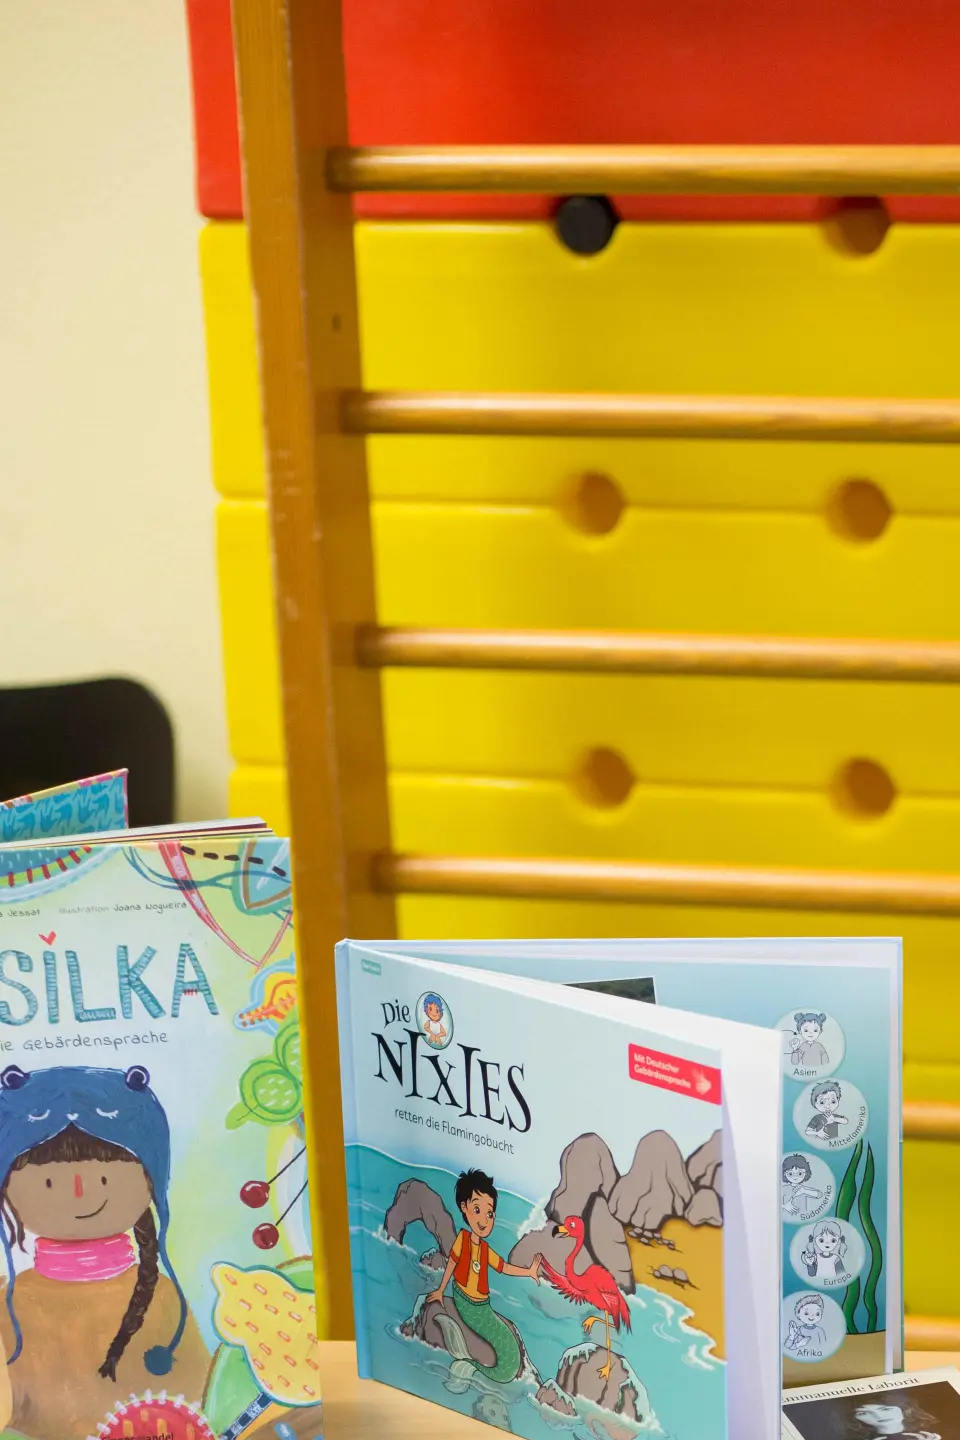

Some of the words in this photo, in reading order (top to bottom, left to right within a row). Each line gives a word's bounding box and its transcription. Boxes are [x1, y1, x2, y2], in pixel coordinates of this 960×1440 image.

[380, 998, 411, 1028] Die
[23, 1031, 169, 1050] Gebärdensprache
[793, 1067, 817, 1077] Asien
[394, 1107, 424, 1126] retten
[426, 1117, 440, 1131] die
[442, 1120, 515, 1155] Flamingobucht
[828, 1105, 867, 1148] Mittelamerika
[823, 1272, 853, 1287] Europa
[796, 1348, 823, 1358] Afrika
[782, 1384, 865, 1404] mmanuelle
[868, 1376, 920, 1393] Laborit
